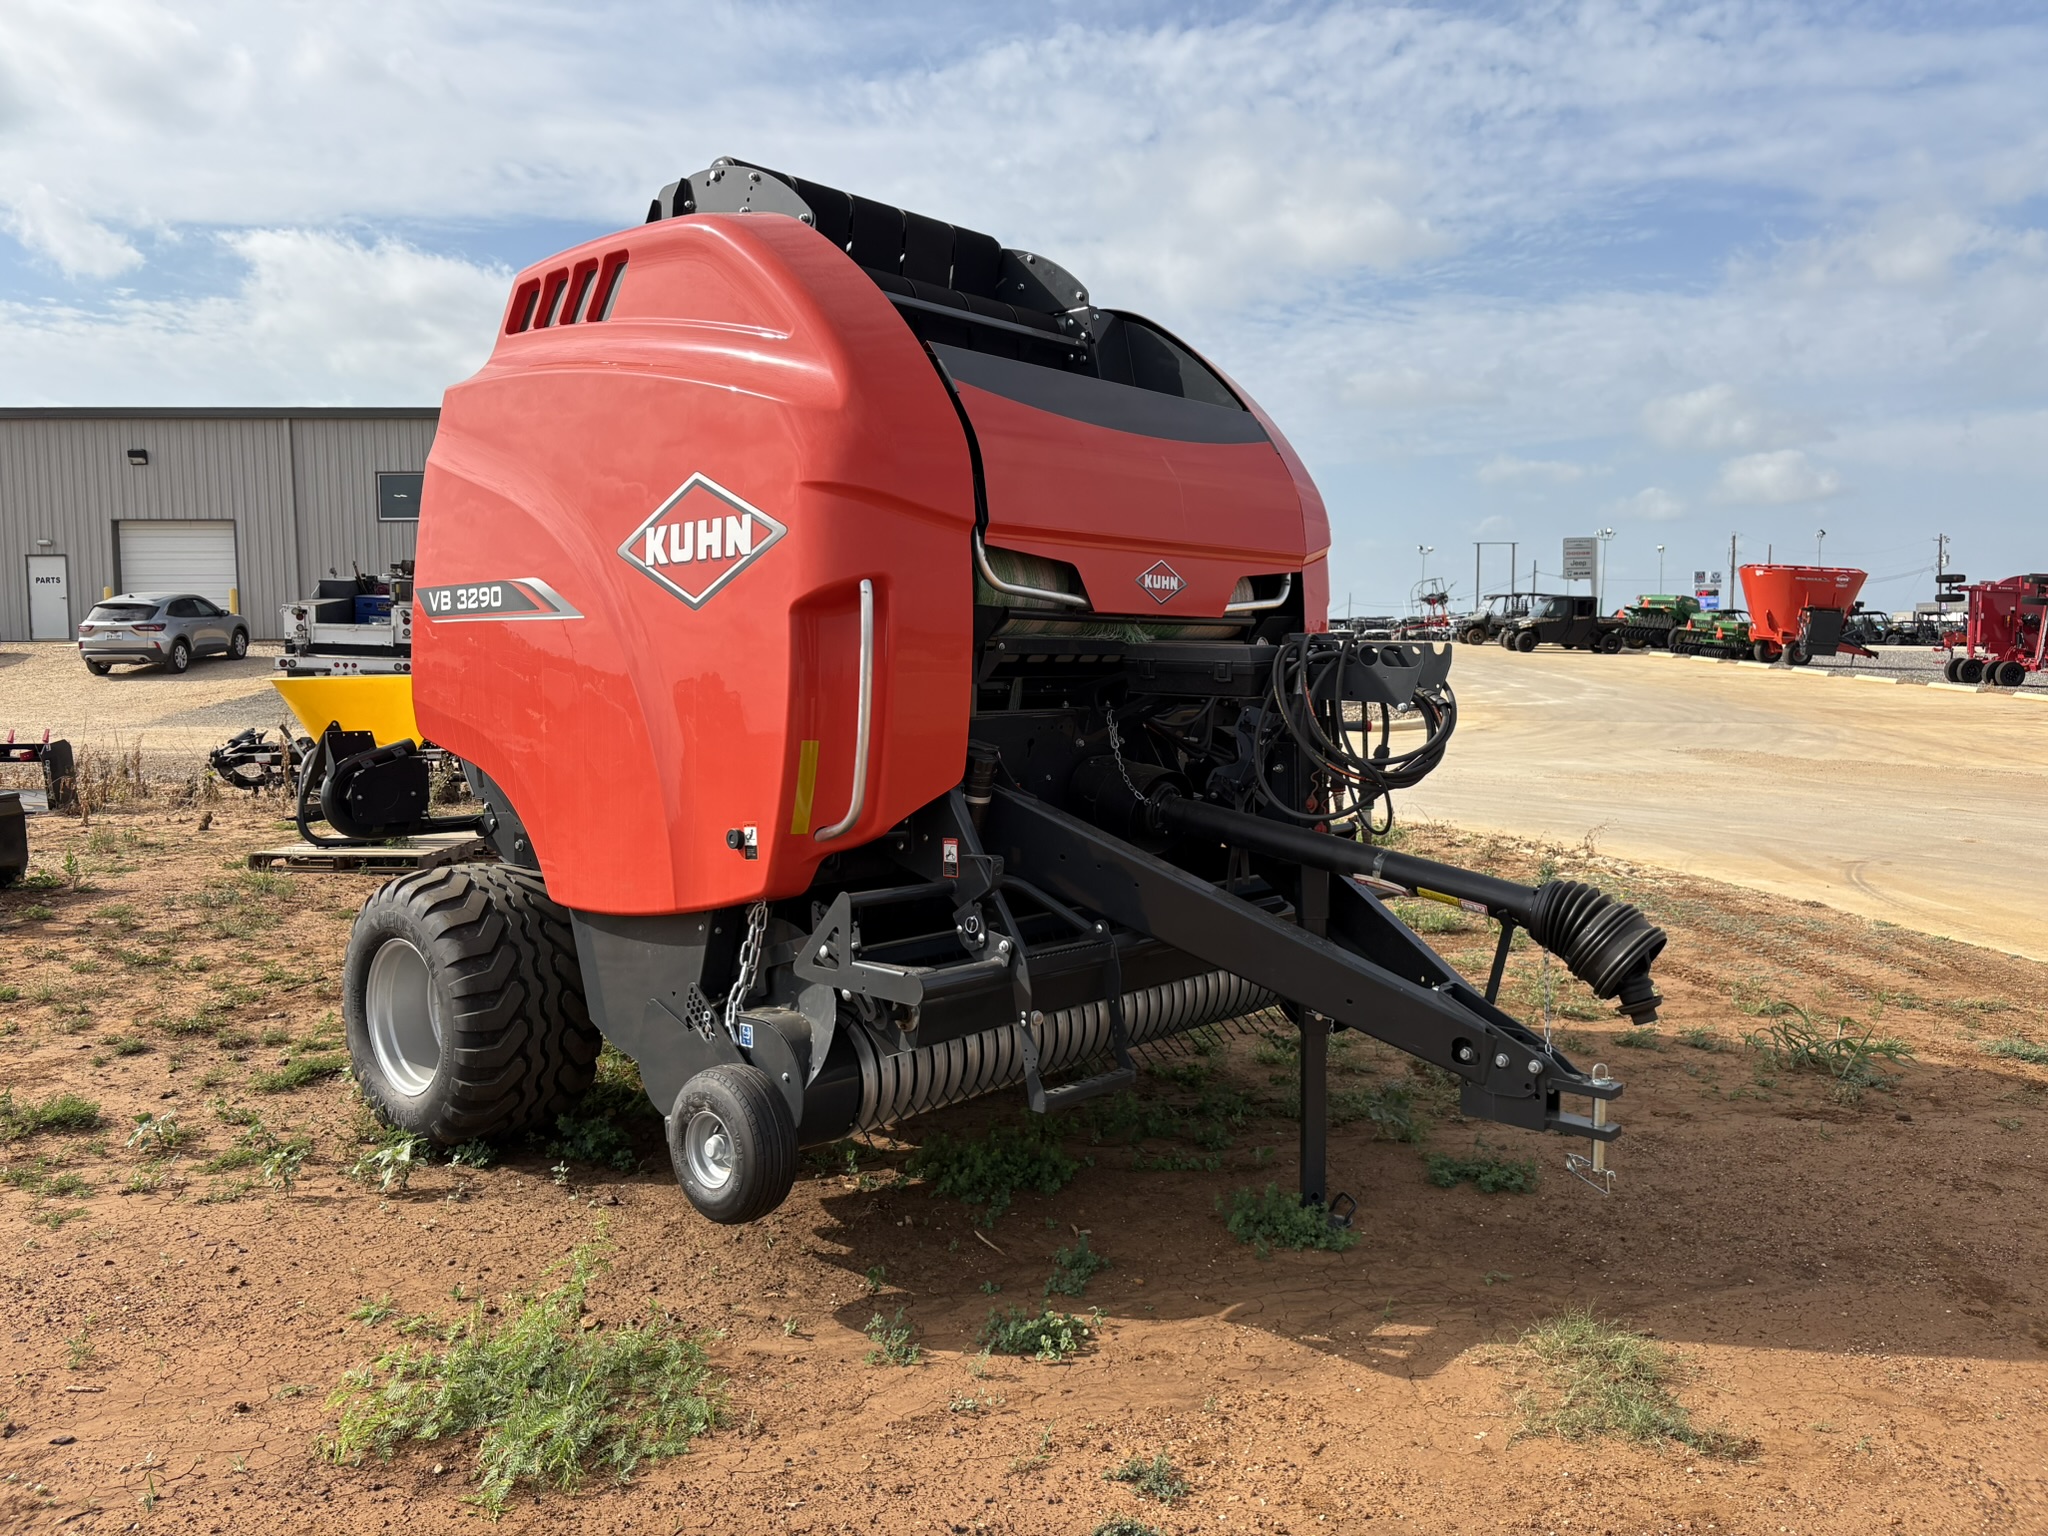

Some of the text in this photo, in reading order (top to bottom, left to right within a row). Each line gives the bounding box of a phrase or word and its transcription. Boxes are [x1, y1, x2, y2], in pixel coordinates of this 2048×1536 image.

[645, 513, 752, 567] KUHN
[1570, 559, 1587, 567] Jeep
[35, 576, 61, 584] PARTS
[1144, 574, 1179, 590] KUHN
[429, 586, 502, 612] VB 3290
